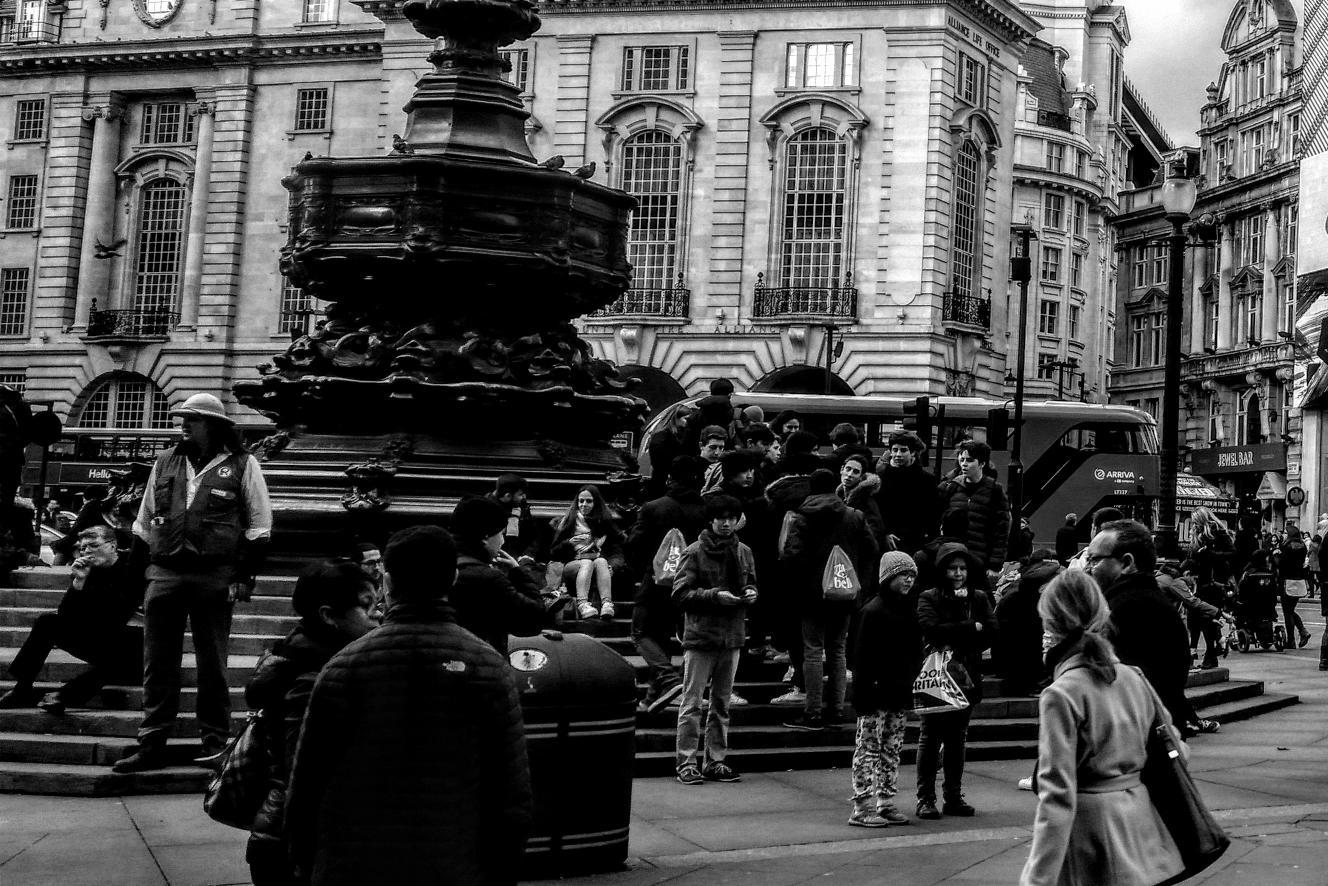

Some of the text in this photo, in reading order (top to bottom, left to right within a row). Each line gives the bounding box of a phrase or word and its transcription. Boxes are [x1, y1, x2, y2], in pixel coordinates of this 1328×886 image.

[1218, 451, 1254, 467] JEWEL BAR
[1106, 471, 1135, 479] ARRIVA
